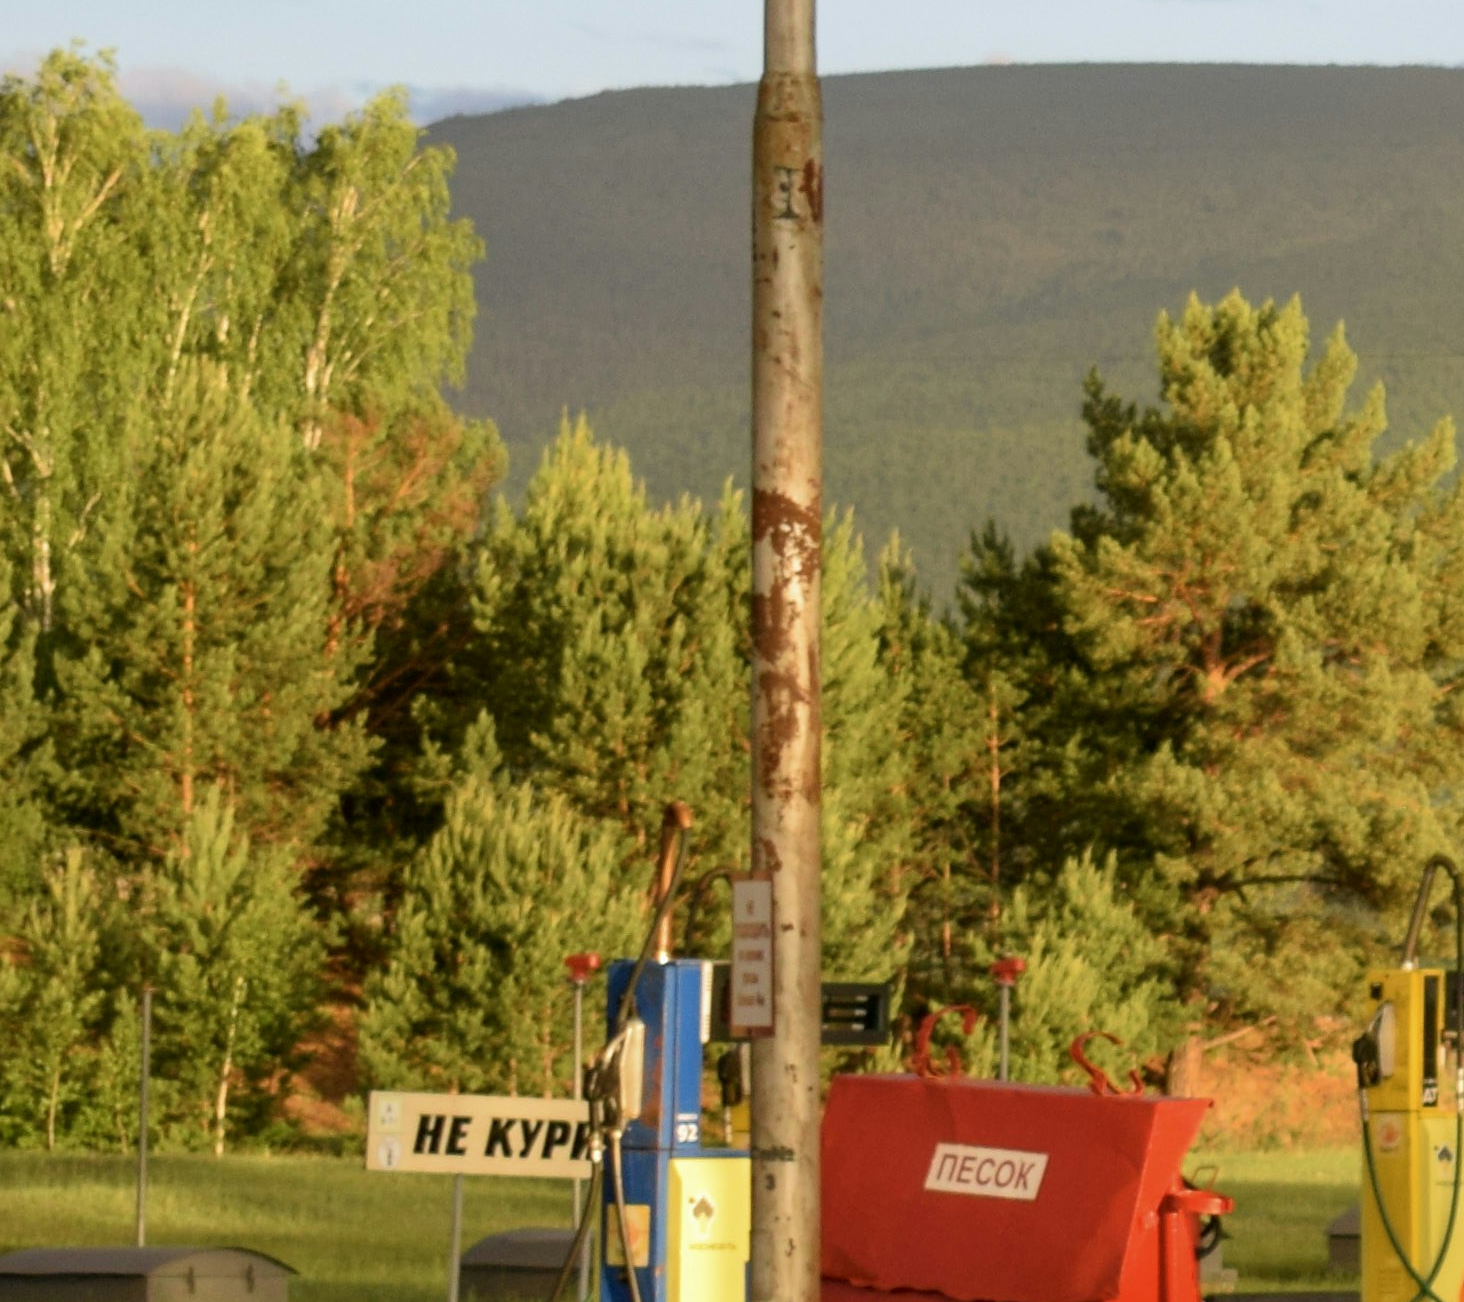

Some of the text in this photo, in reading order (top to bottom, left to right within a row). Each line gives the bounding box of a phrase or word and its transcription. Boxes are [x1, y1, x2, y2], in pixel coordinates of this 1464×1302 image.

[413, 1114, 471, 1156] НЕ
[676, 1123, 698, 1143] 92
[936, 1153, 1036, 1190] ПЕСОК
